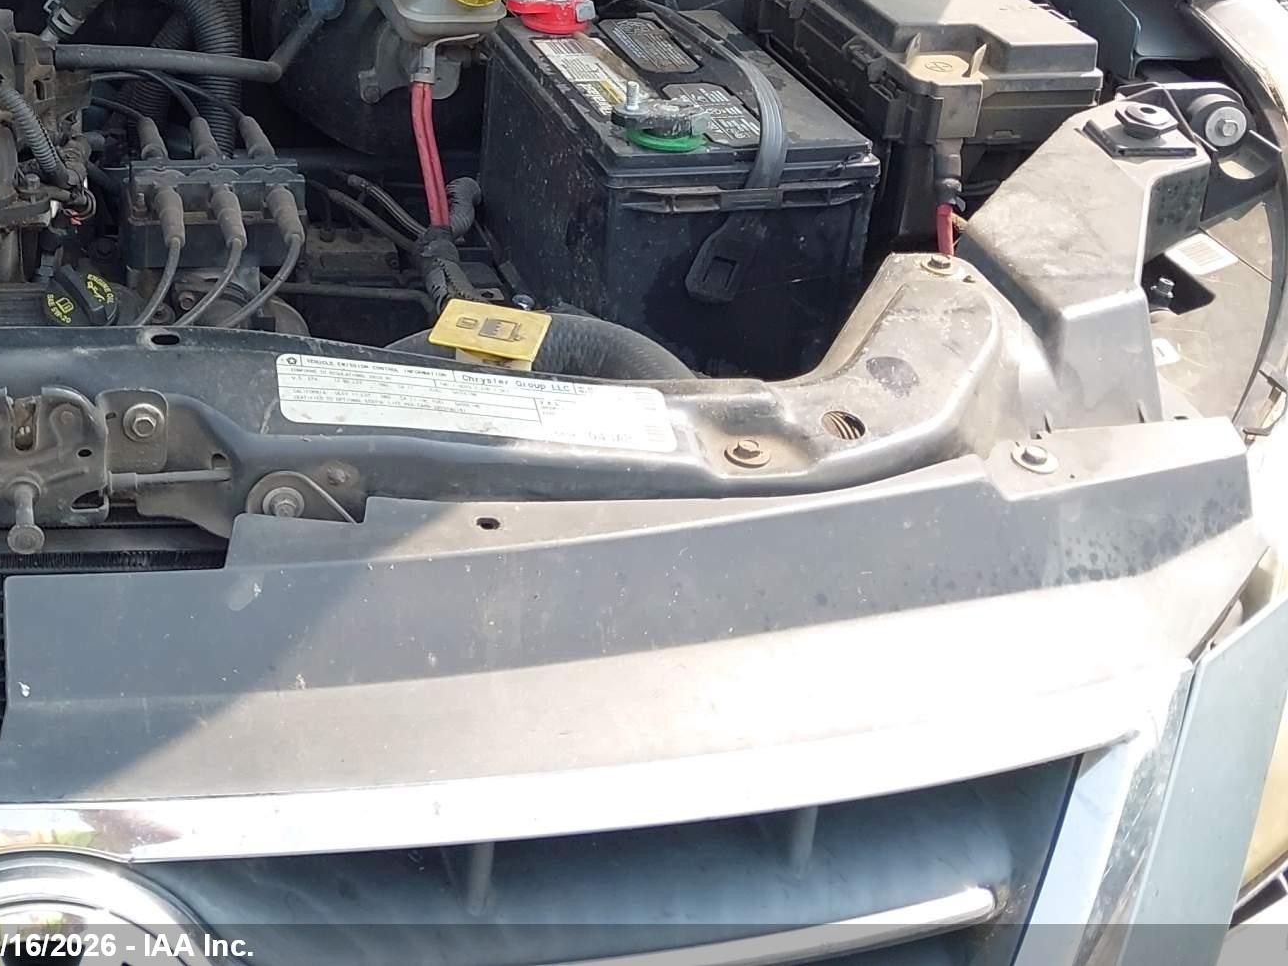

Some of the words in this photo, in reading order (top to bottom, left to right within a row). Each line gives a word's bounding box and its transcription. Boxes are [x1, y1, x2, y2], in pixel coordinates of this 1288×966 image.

[87, 273, 112, 293] ENGINE
[106, 293, 114, 304] OIL
[462, 374, 508, 385] Chrysler
[515, 380, 546, 391] Group
[552, 384, 570, 392] LLC
